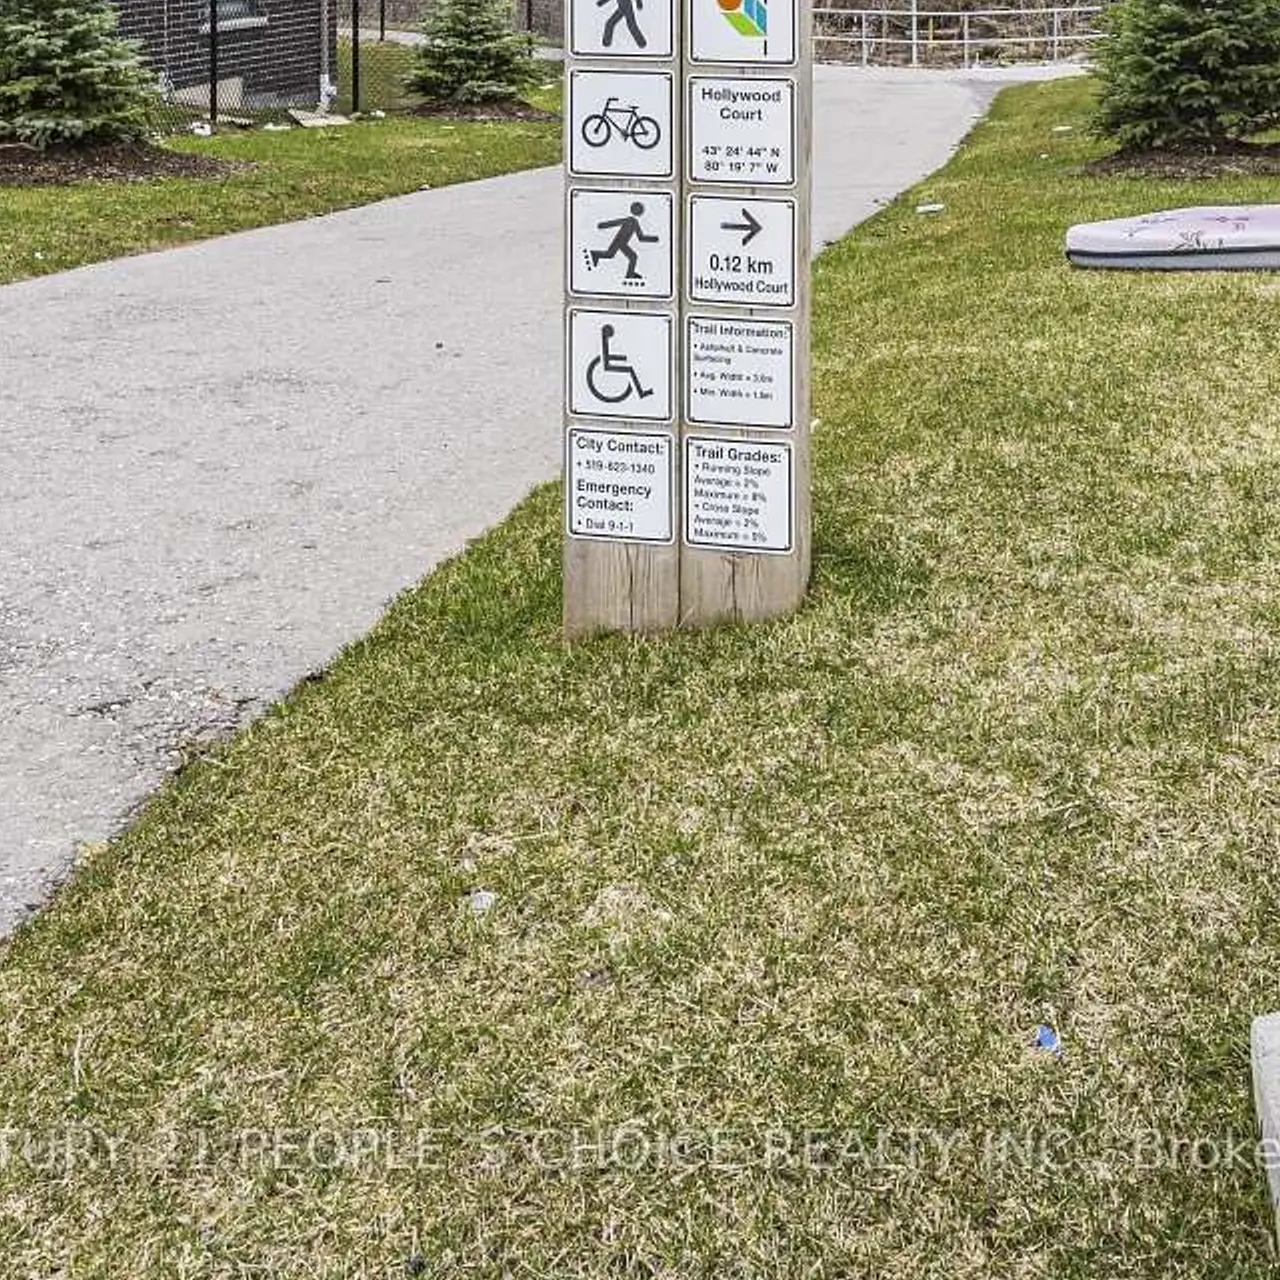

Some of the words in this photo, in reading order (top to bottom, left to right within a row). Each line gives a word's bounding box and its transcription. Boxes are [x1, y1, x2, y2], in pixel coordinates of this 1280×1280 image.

[702, 87, 781, 103] Hollywood
[720, 107, 762, 121] Court
[770, 148, 780, 157] N
[766, 162, 778, 173] W
[710, 254, 741, 272] 0.12
[747, 256, 773, 274] km
[695, 276, 754, 292] Hollywood
[756, 280, 788, 293] Court
[694, 324, 717, 335] Trail
[720, 325, 787, 338] Information:
[577, 436, 603, 452] City
[608, 439, 664, 454] Contact:
[695, 445, 723, 459] Trail
[728, 448, 782, 463] Grades:
[577, 479, 651, 498] Emergency
[577, 496, 633, 511] Contact:
[586, 518, 605, 529] Dial
